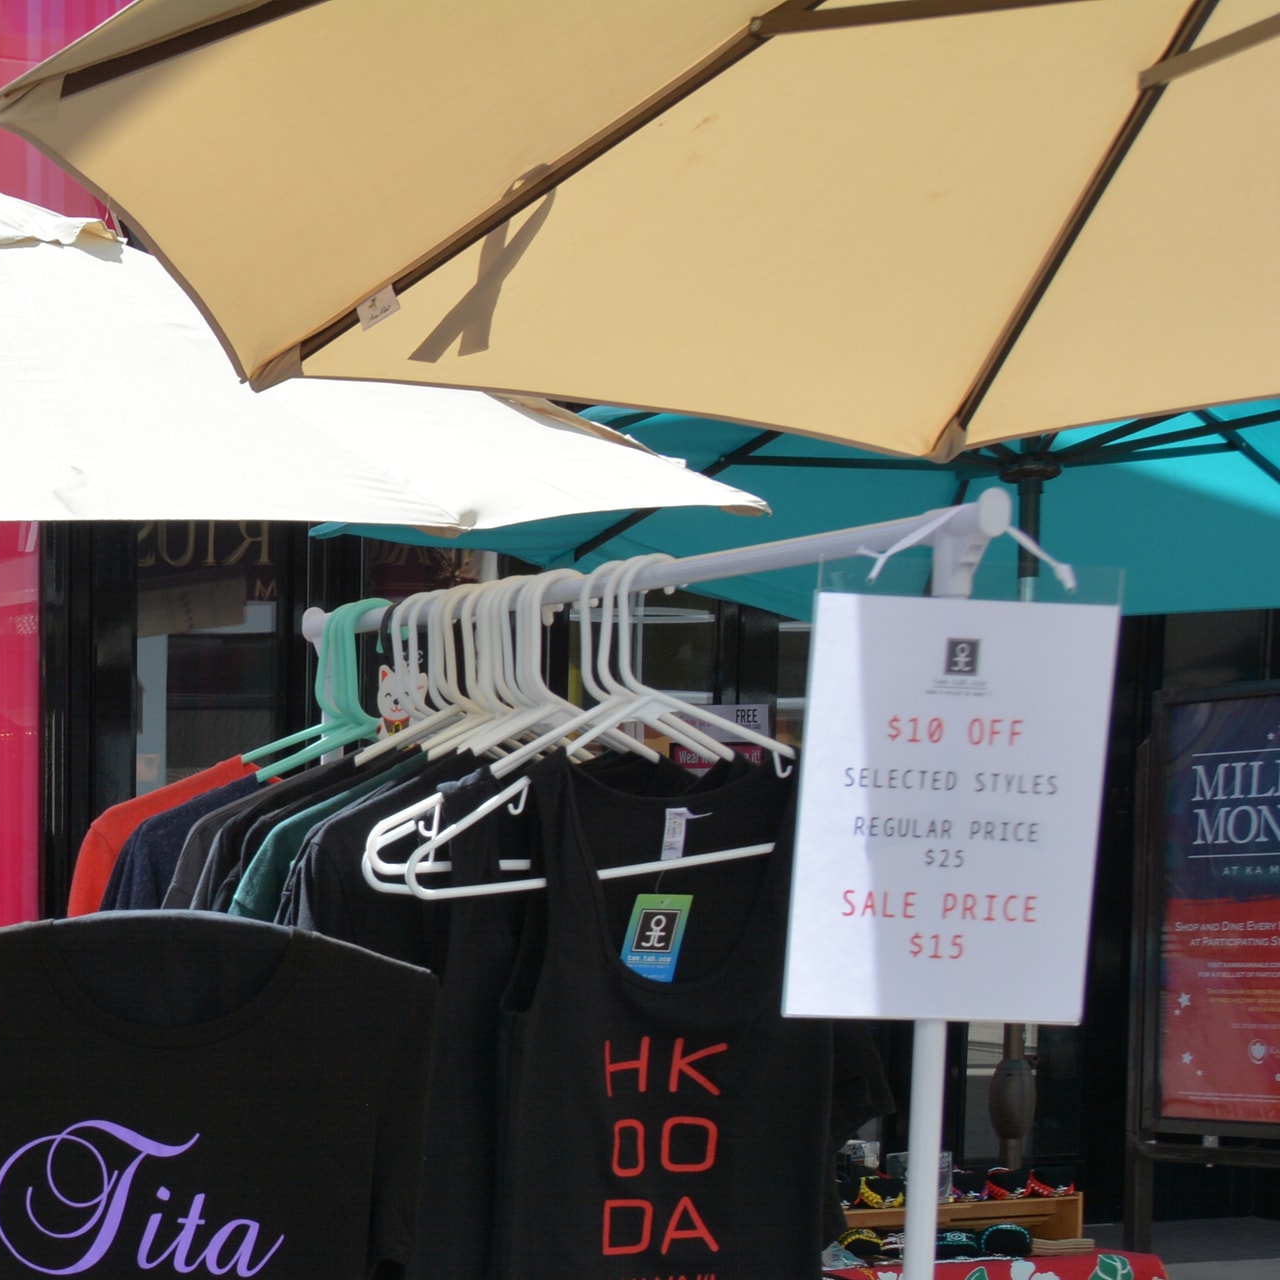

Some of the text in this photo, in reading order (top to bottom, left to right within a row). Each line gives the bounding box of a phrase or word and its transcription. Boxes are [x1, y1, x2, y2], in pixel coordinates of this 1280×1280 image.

[735, 709, 758, 724] FREE
[887, 715, 1024, 747] $10 OFF
[843, 767, 1059, 796] SELECTED STYLES
[853, 816, 1040, 843] REGULAR PRICE
[924, 848, 965, 868] $25
[842, 890, 1038, 923] SALE PRICE
[908, 932, 964, 961] $15
